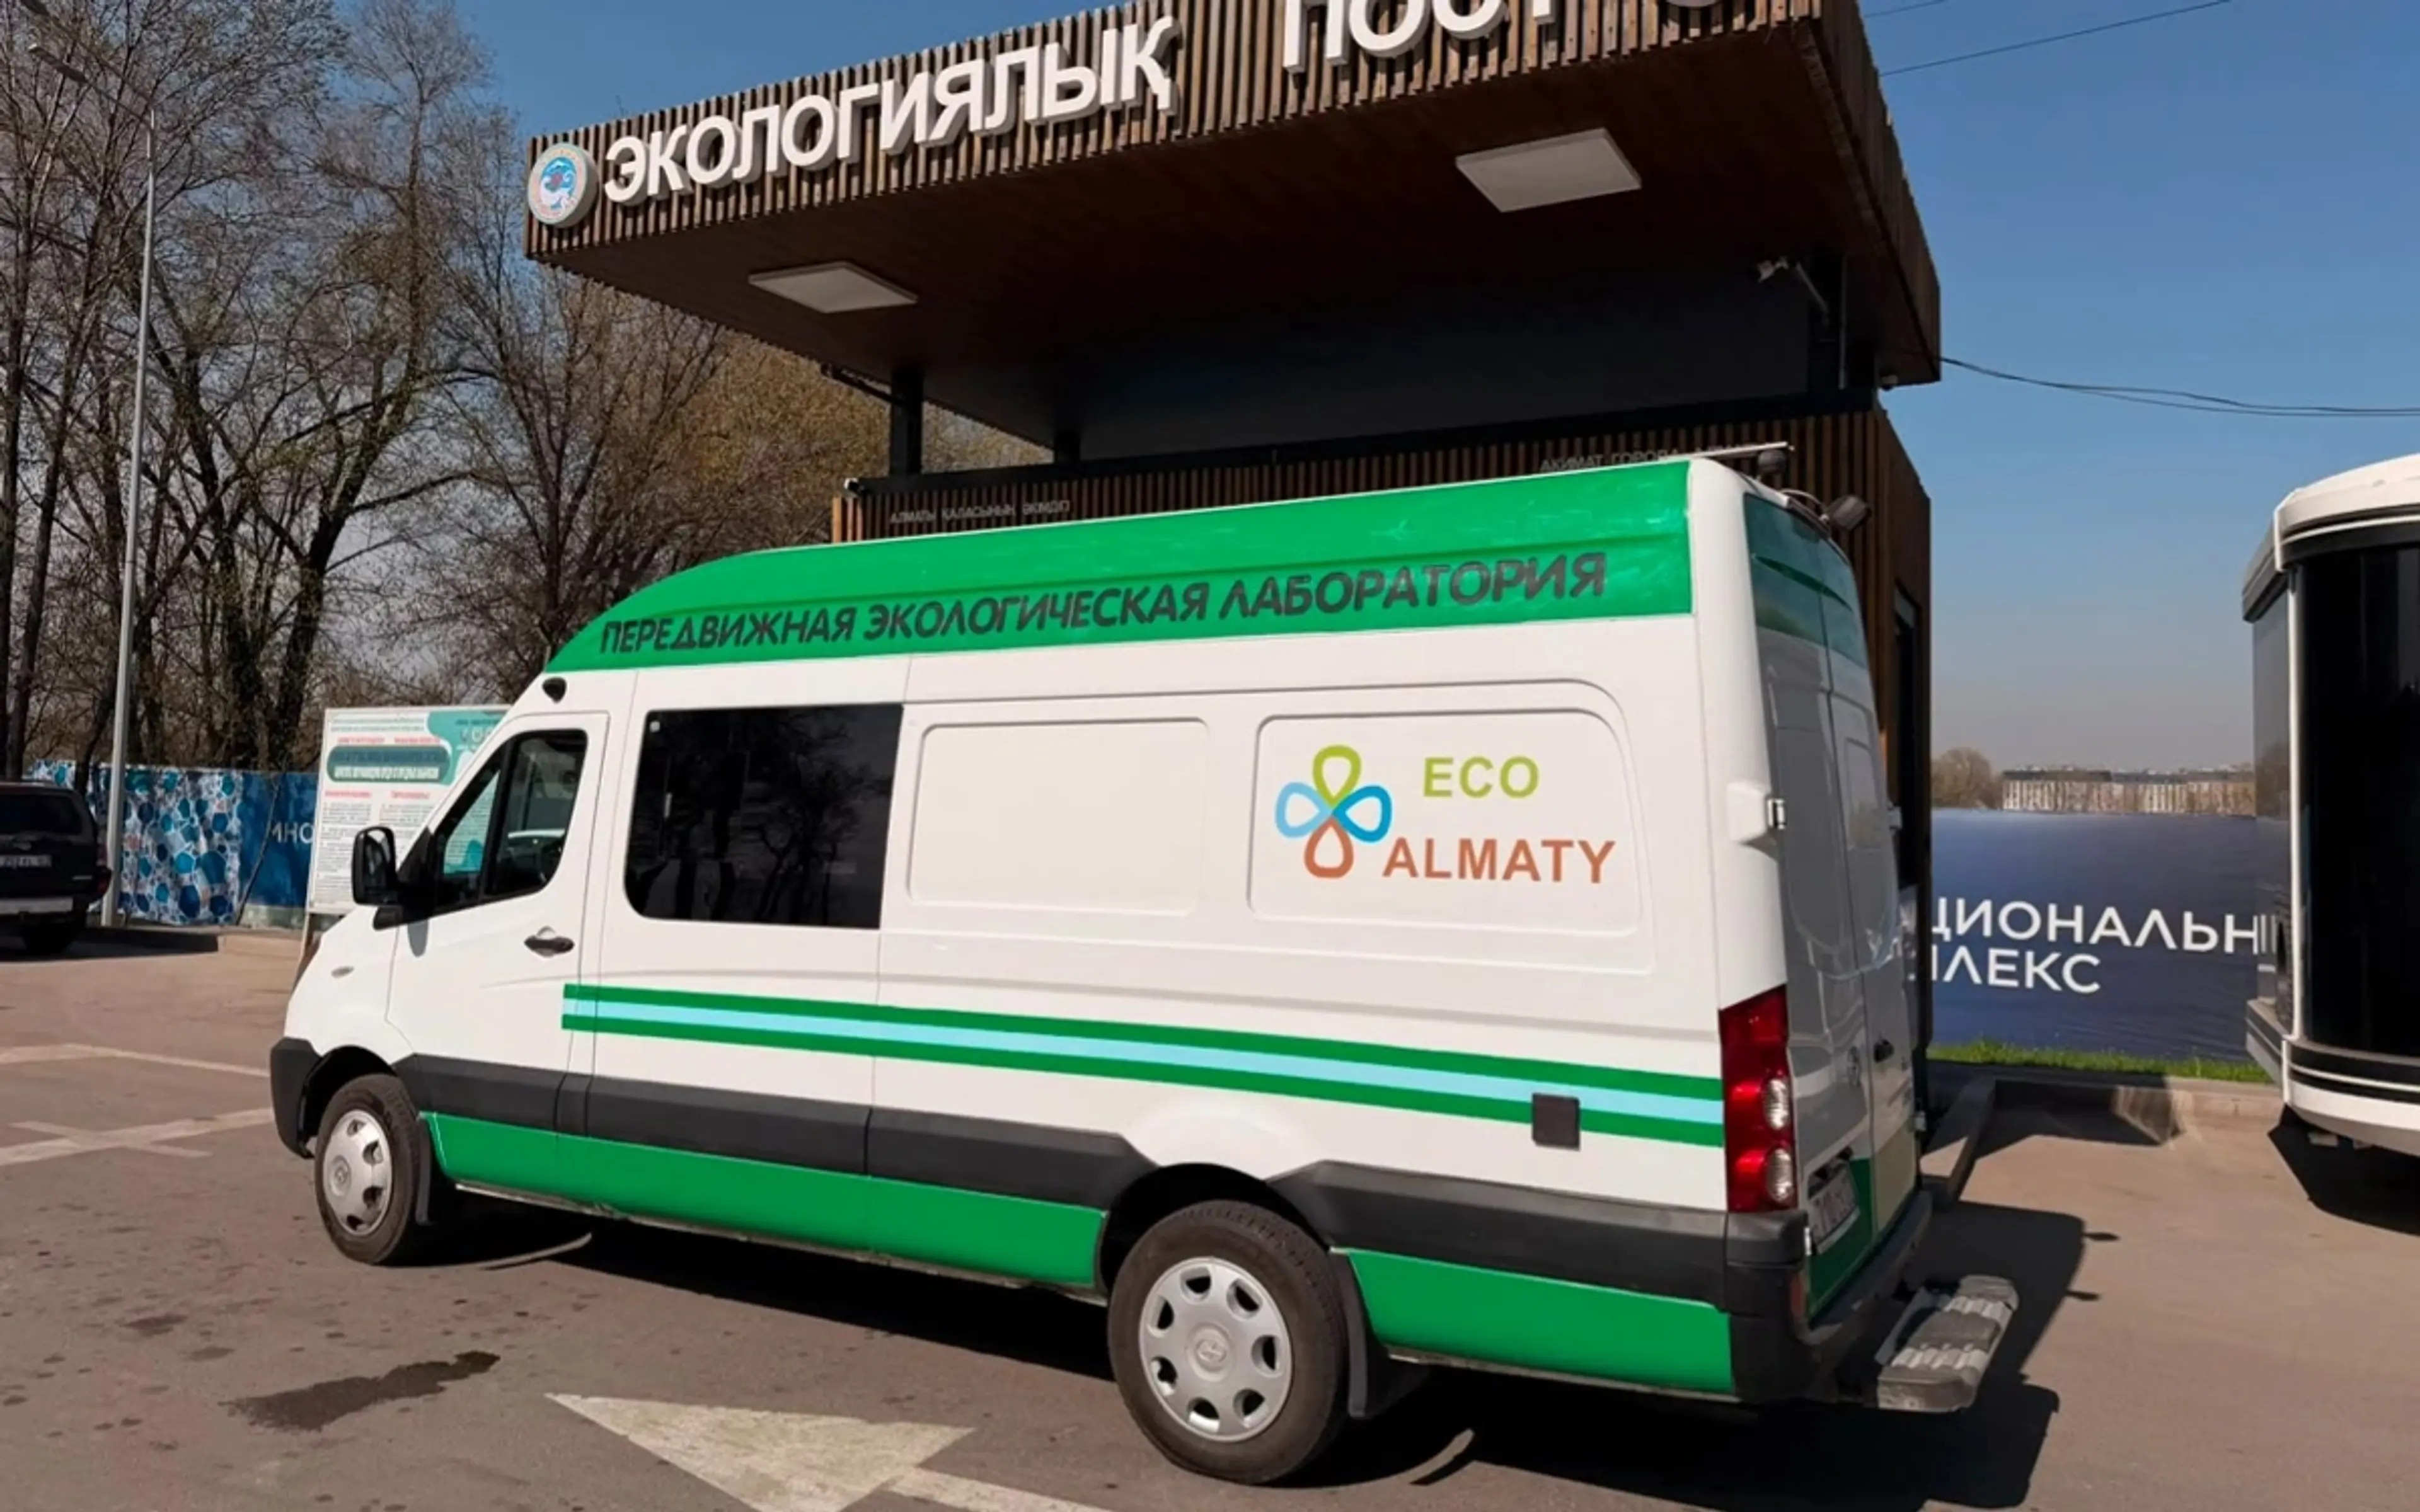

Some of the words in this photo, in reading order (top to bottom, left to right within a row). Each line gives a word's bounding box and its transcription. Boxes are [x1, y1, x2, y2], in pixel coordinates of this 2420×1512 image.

[603, 15, 1177, 204] ЭКОЛОГИЯЛЫҚ
[599, 606, 856, 654] ПЕРЕДВИЖНАЯ
[865, 581, 1210, 641] ЭКОЛОГИЧЕСКАЯ
[1218, 553, 1607, 620] ЛАБОРАТОРИЯ
[1422, 755, 1540, 799] ECO
[1382, 837, 1615, 884] ALMATY
[1932, 944, 2101, 994] ЛЕКС
